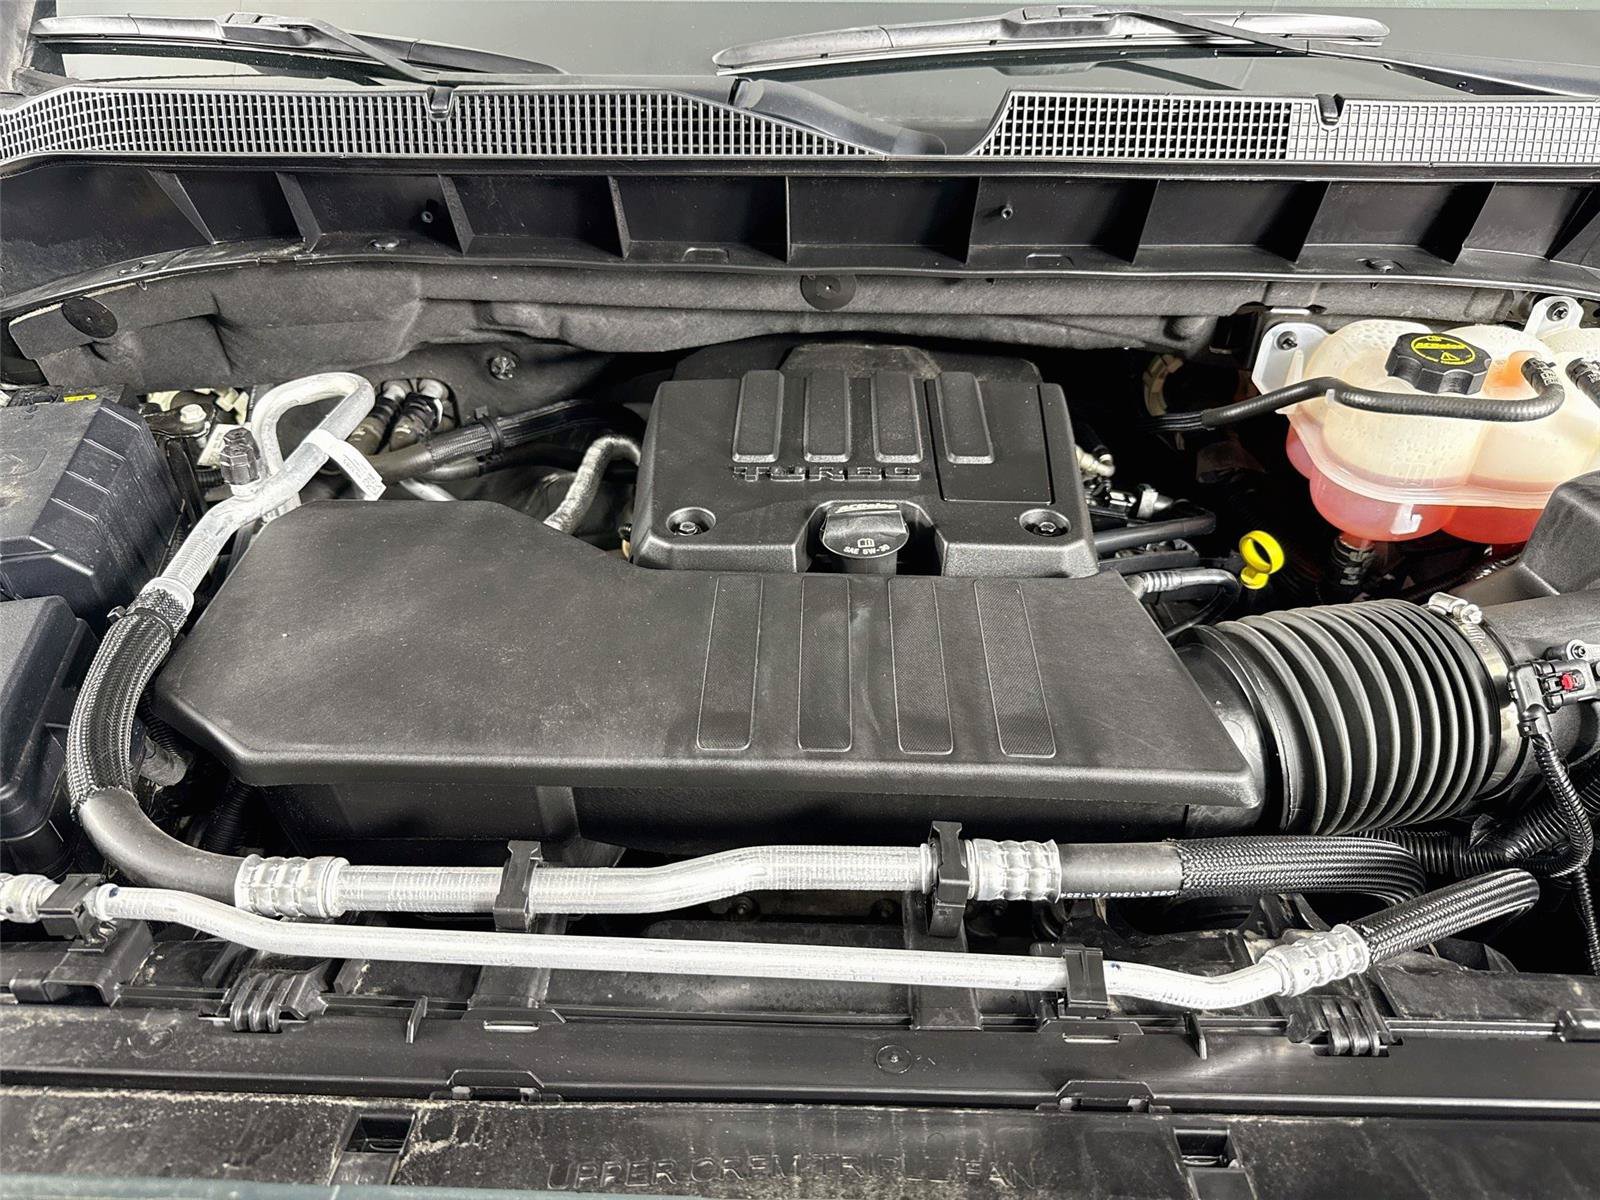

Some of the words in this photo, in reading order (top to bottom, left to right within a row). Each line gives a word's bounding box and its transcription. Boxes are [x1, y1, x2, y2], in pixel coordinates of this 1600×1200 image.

[733, 466, 921, 482] TURBO
[834, 503, 898, 514] ACDelco
[843, 546, 860, 555] SAE
[547, 1157, 678, 1190] UPPER
